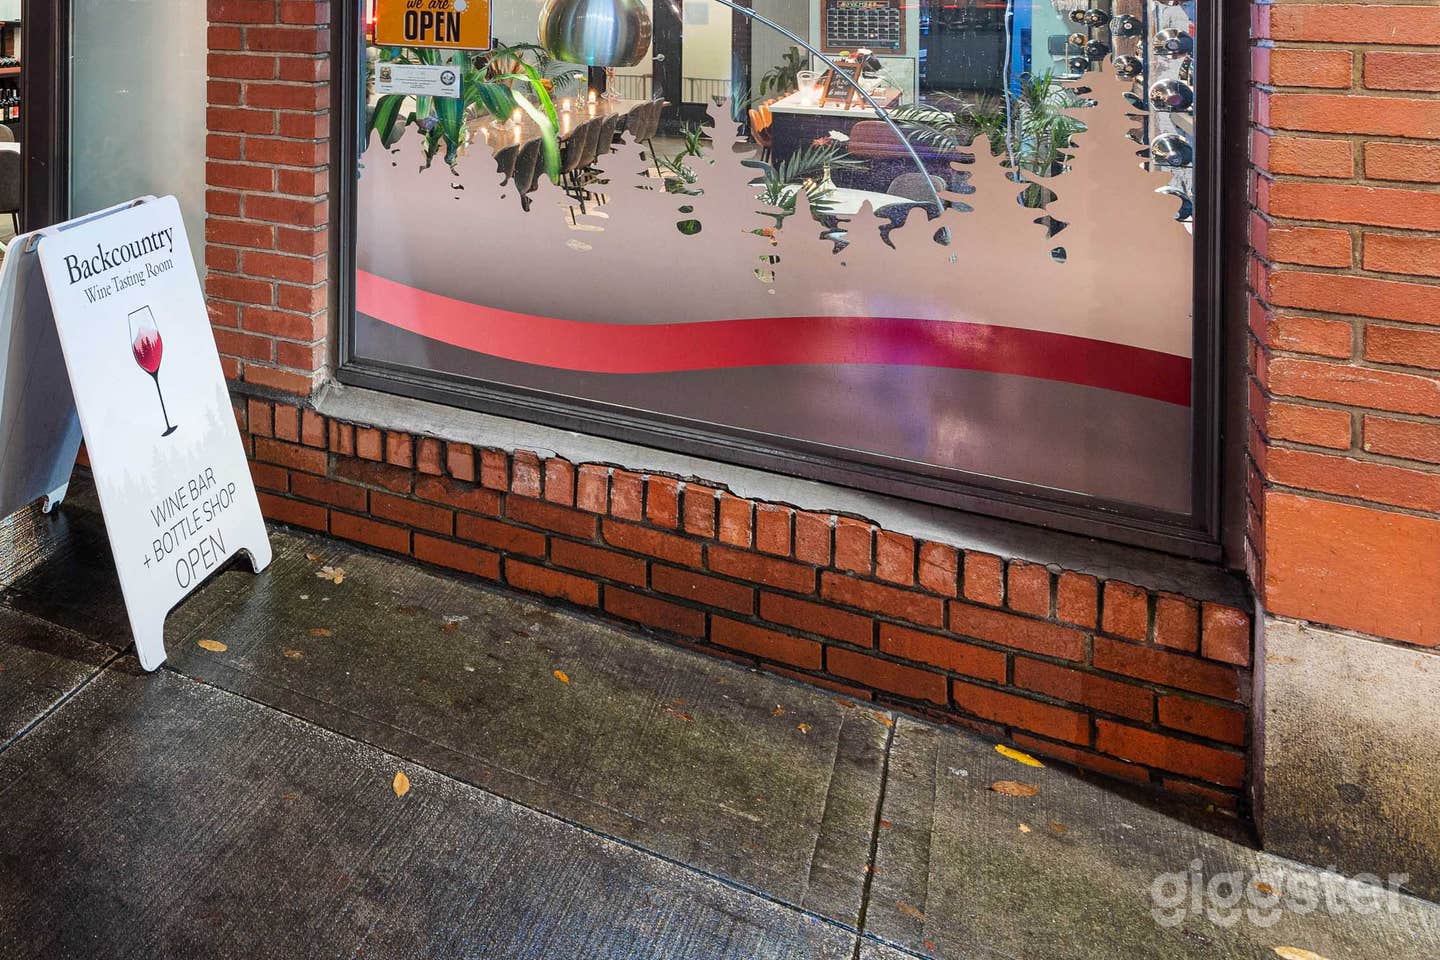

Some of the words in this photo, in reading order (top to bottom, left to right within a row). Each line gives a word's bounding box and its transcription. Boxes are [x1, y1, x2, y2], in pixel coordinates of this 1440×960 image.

[404, 10, 461, 43] OPEN
[428, 0, 450, 9] are
[63, 227, 173, 286] Backcountry
[83, 284, 112, 304] Wine
[111, 271, 147, 292] Tasting
[145, 258, 174, 278] Room
[150, 486, 189, 528] WINE
[188, 467, 217, 501] BAR
[152, 508, 203, 562] BOTTLE
[202, 482, 236, 522] SHOP
[175, 528, 227, 589] OPEN
